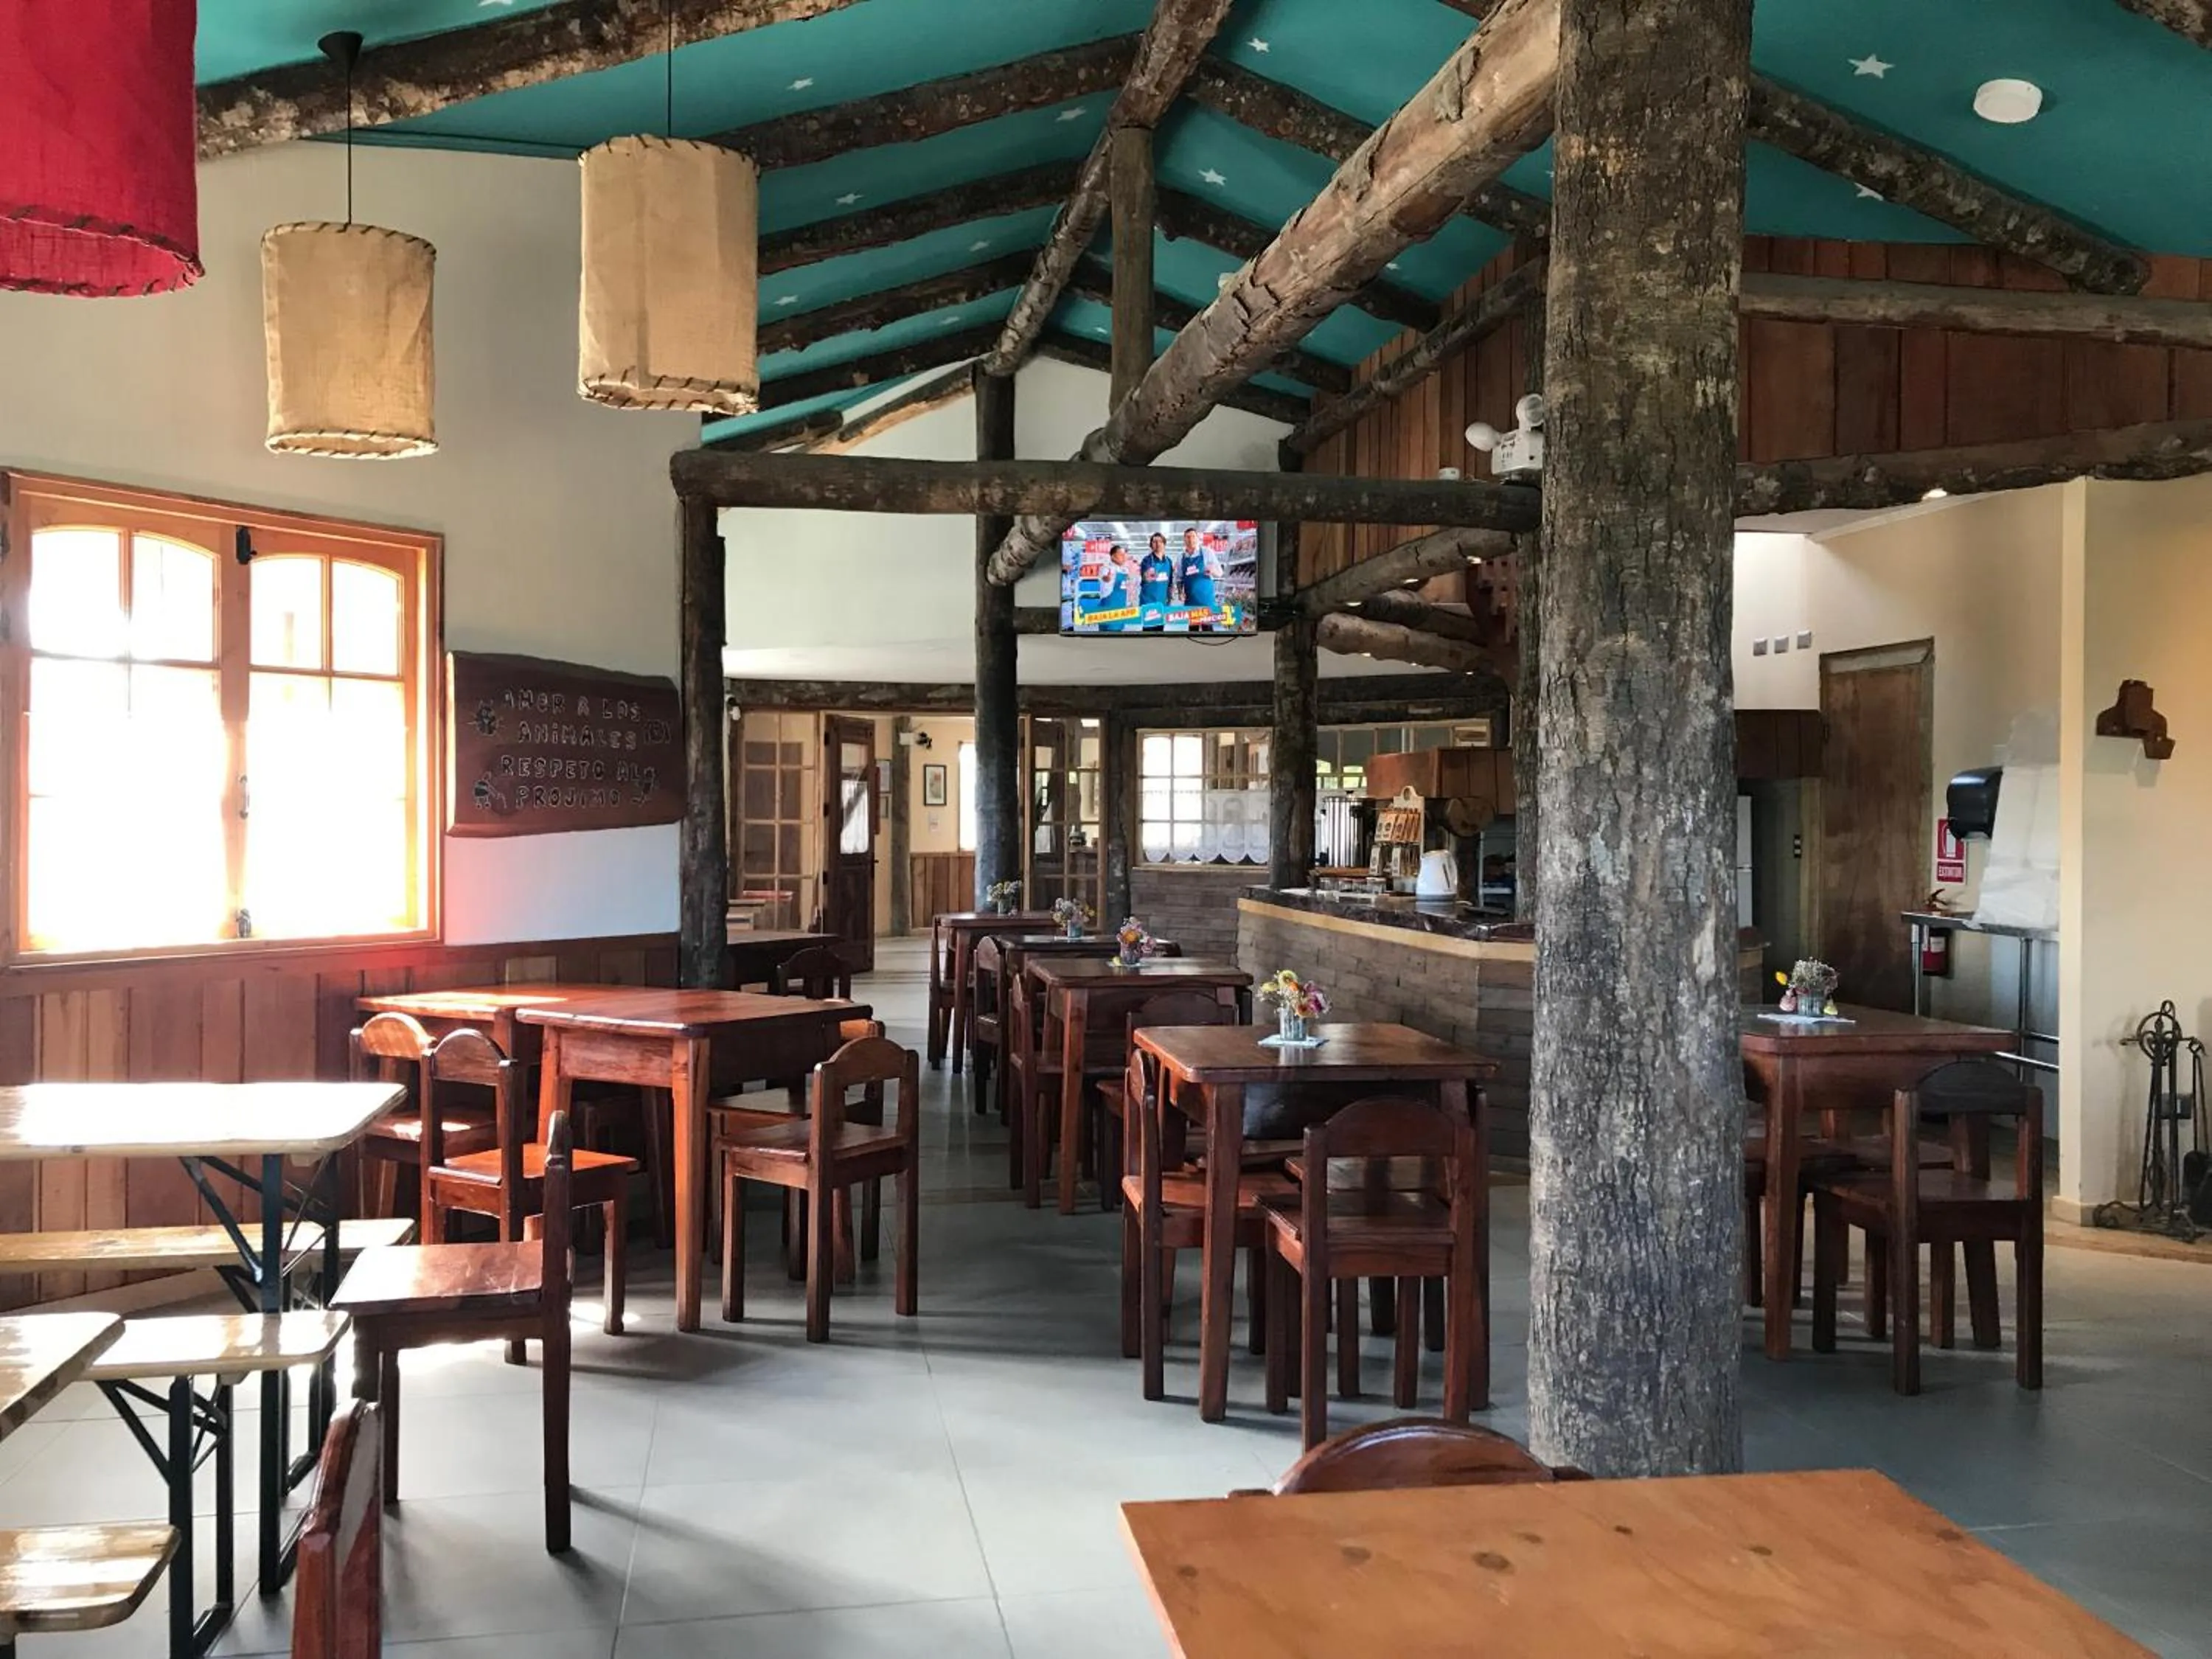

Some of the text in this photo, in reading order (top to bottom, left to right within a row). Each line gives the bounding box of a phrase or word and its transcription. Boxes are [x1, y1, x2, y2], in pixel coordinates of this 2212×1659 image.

[577, 695, 591, 717] A
[501, 754, 605, 780] RESPETO
[515, 785, 621, 808] PROJIMO
